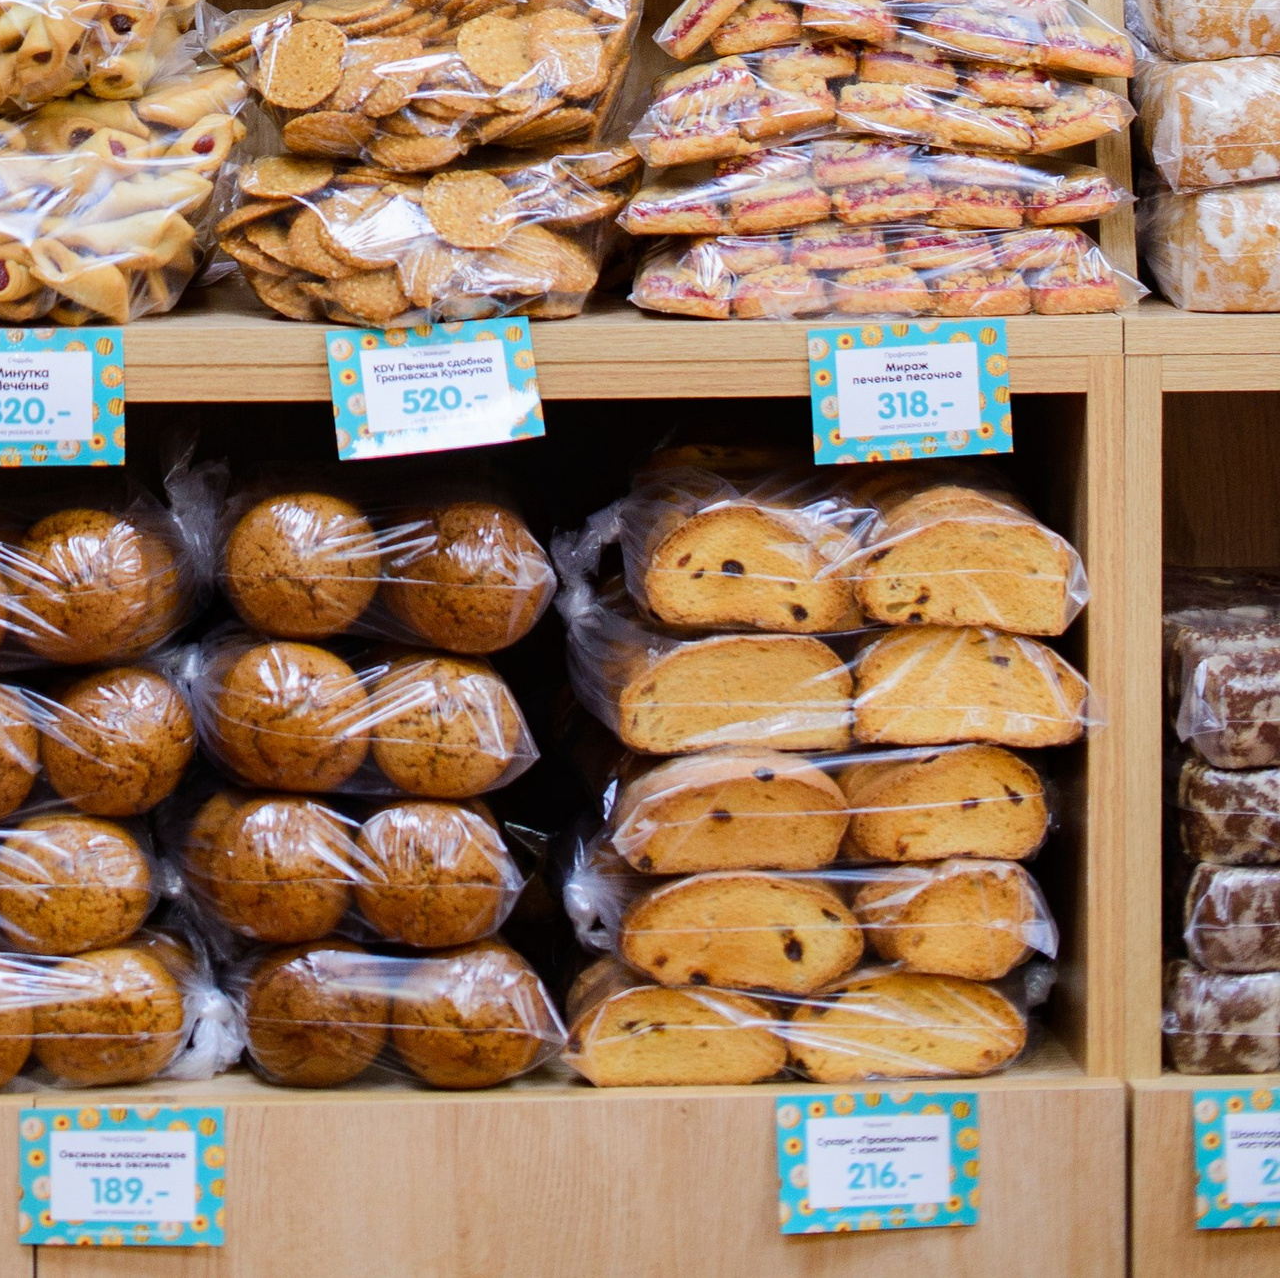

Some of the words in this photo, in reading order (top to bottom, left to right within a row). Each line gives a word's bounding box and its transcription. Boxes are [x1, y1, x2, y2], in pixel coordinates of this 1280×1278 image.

[373, 363, 395, 373] KDV
[398, 361, 444, 372] Печенье
[447, 356, 493, 368] сдобное
[885, 362, 929, 373] Мираж
[853, 375, 902, 385] печенье
[906, 371, 962, 381] песочное
[402, 385, 488, 415] 520.-
[878, 390, 954, 420] 318.-
[59, 1150, 107, 1160] Овсяное
[110, 1151, 187, 1159] классическое
[75, 1161, 122, 1169] печенье
[847, 1161, 923, 1191] 216.-
[90, 1177, 170, 1205] 189.-
